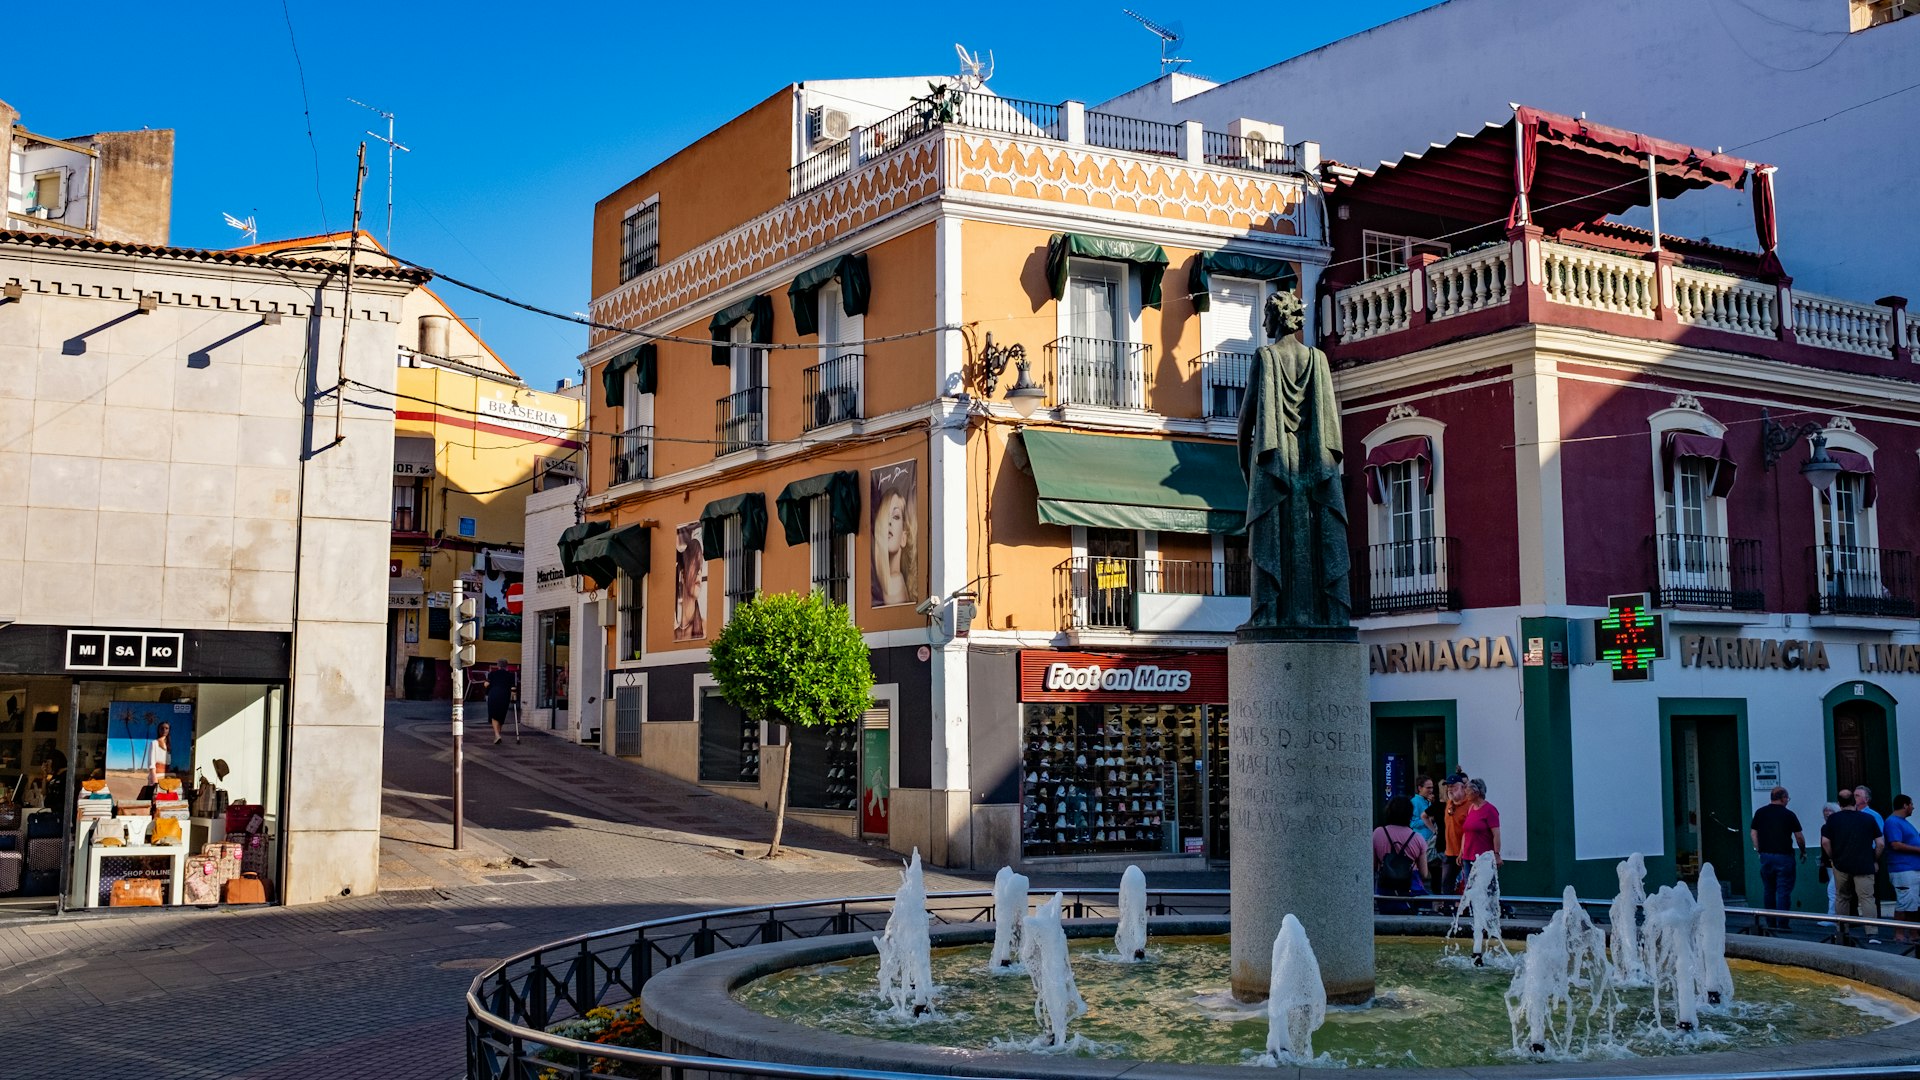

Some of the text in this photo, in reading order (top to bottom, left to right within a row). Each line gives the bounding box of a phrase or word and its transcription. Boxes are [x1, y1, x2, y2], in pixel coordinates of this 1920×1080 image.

[489, 400, 558, 424] BRASERIA
[536, 567, 564, 583] Martina
[79, 645, 173, 657] MI SA KO
[1370, 635, 1518, 674] ARMACIA
[1680, 635, 1830, 670] FARMACIA
[1051, 664, 1189, 689] Foot on Mars
[122, 869, 171, 877] SHOP ONLINE
